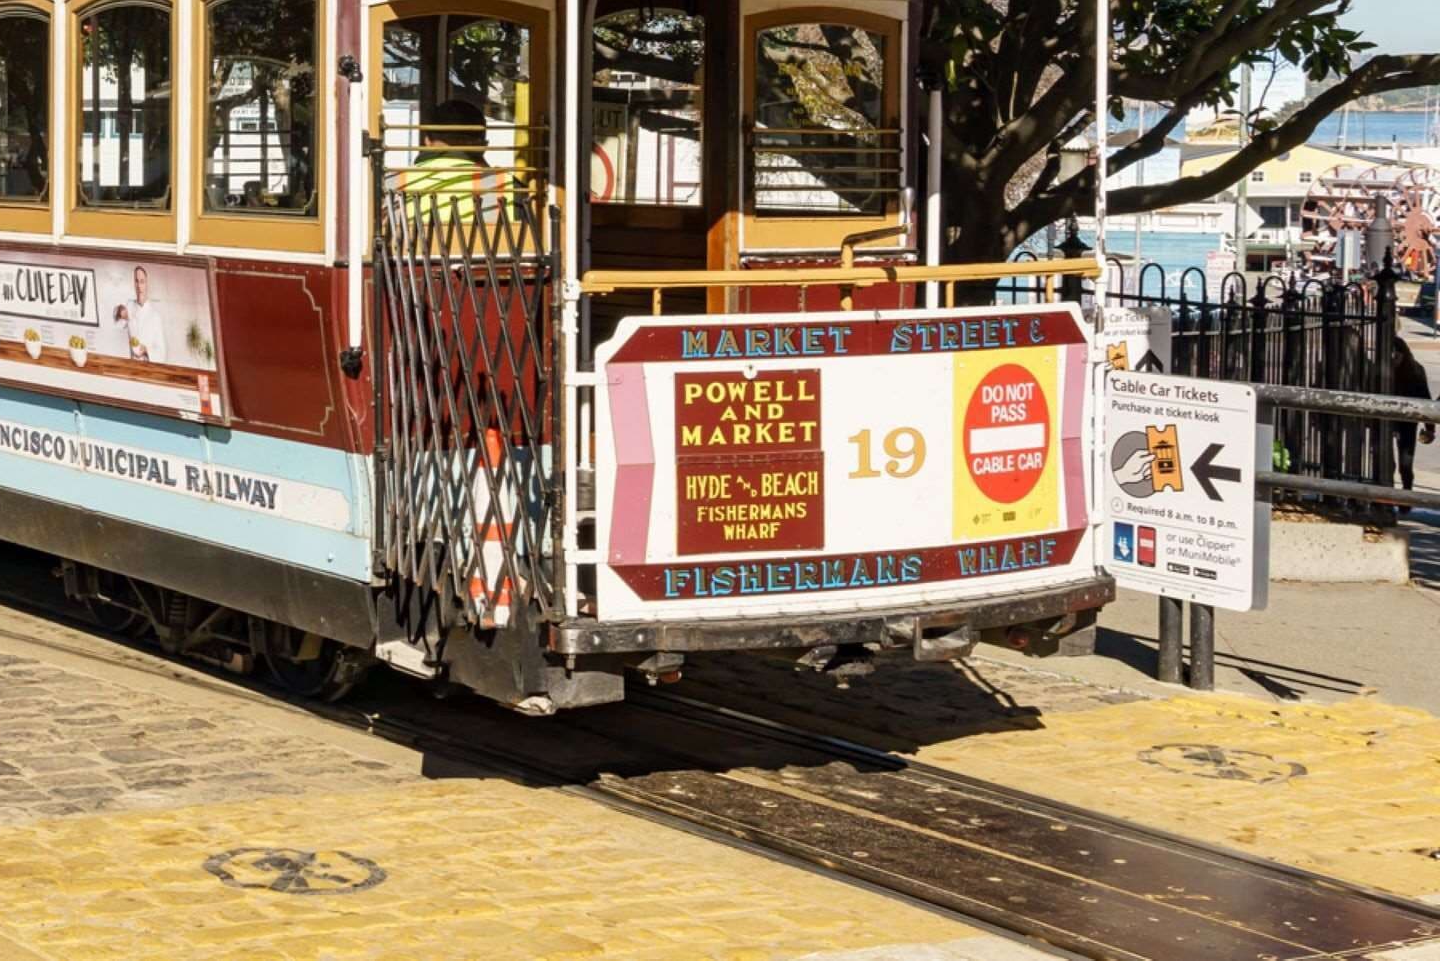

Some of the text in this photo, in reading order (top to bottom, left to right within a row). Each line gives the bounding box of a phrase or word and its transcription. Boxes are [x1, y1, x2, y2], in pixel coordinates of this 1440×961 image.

[59, 272, 87, 318] DAY
[681, 325, 853, 359] MARKET
[890, 318, 1019, 353] STREET
[683, 379, 816, 405] POWELL
[982, 382, 1035, 404] DO NOT
[1113, 379, 1219, 403] Cable Car Tickets
[720, 403, 785, 421] AND
[991, 403, 1027, 424] PASS
[1112, 400, 1220, 423] Purchase at ticket kiosk
[681, 421, 817, 447] MARKET
[847, 426, 927, 480] 19
[972, 452, 1043, 476] CABLE CAR
[69, 439, 177, 486] MUNICIPAL
[185, 464, 280, 510] RAILWAY
[686, 471, 820, 500] HYDE AND BEACH
[697, 502, 808, 523] FISHERMANS
[1127, 502, 1166, 518] Required
[1167, 510, 1173, 519] 8
[1176, 512, 1195, 523] a.m.
[1197, 514, 1208, 525] to
[1217, 519, 1238, 530] p.m.
[723, 521, 781, 541] WHARF
[1166, 533, 1177, 542] or
[1179, 537, 1194, 546] use
[1166, 547, 1176, 555] or
[664, 539, 1057, 597] FISHERMANS WHARF
